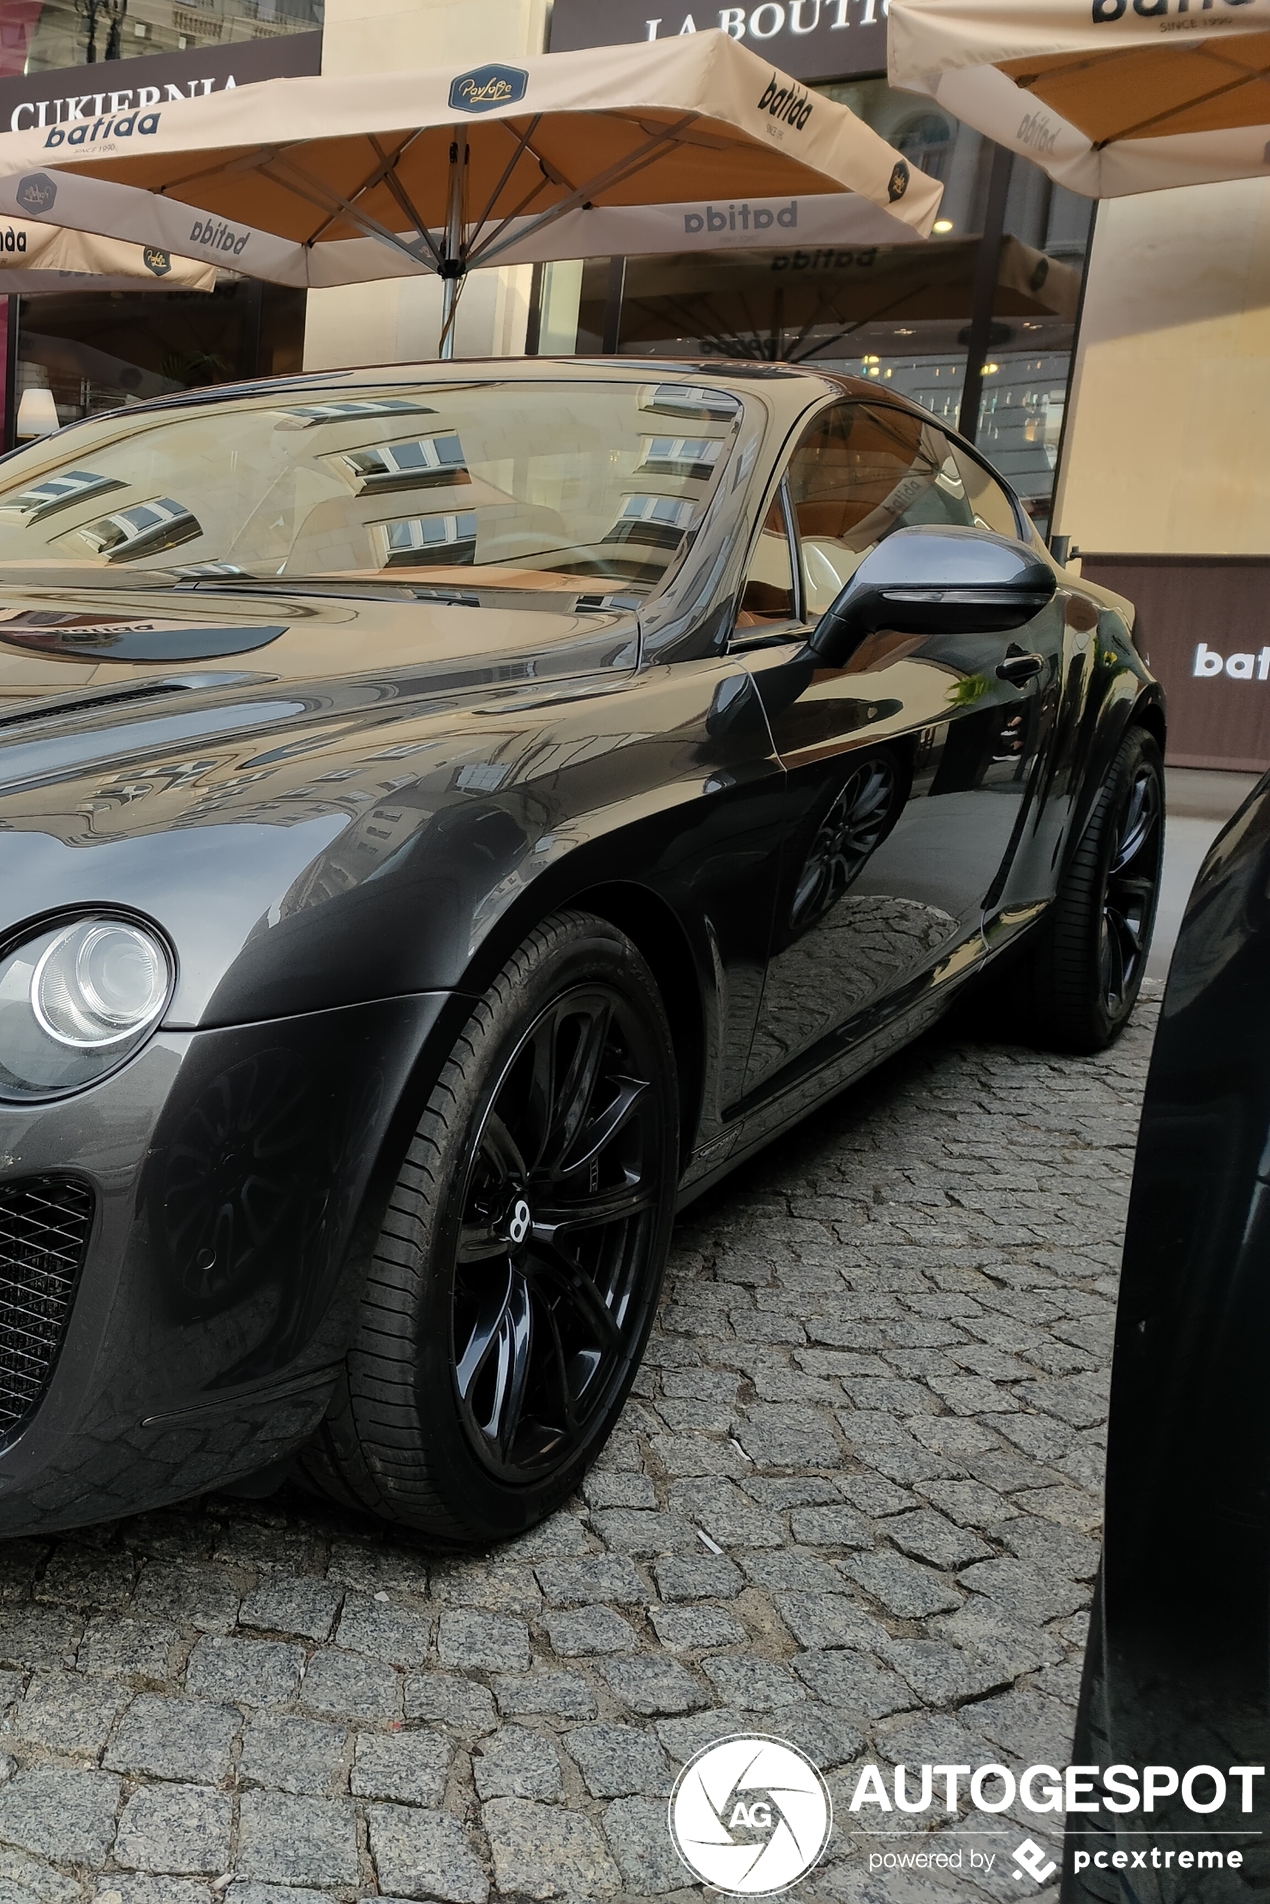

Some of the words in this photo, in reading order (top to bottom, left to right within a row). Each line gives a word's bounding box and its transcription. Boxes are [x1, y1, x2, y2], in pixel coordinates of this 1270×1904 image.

[718, 0, 890, 42] BOUTI
[757, 71, 813, 131] batida
[43, 111, 162, 149] batida
[1193, 643, 1270, 680] bat
